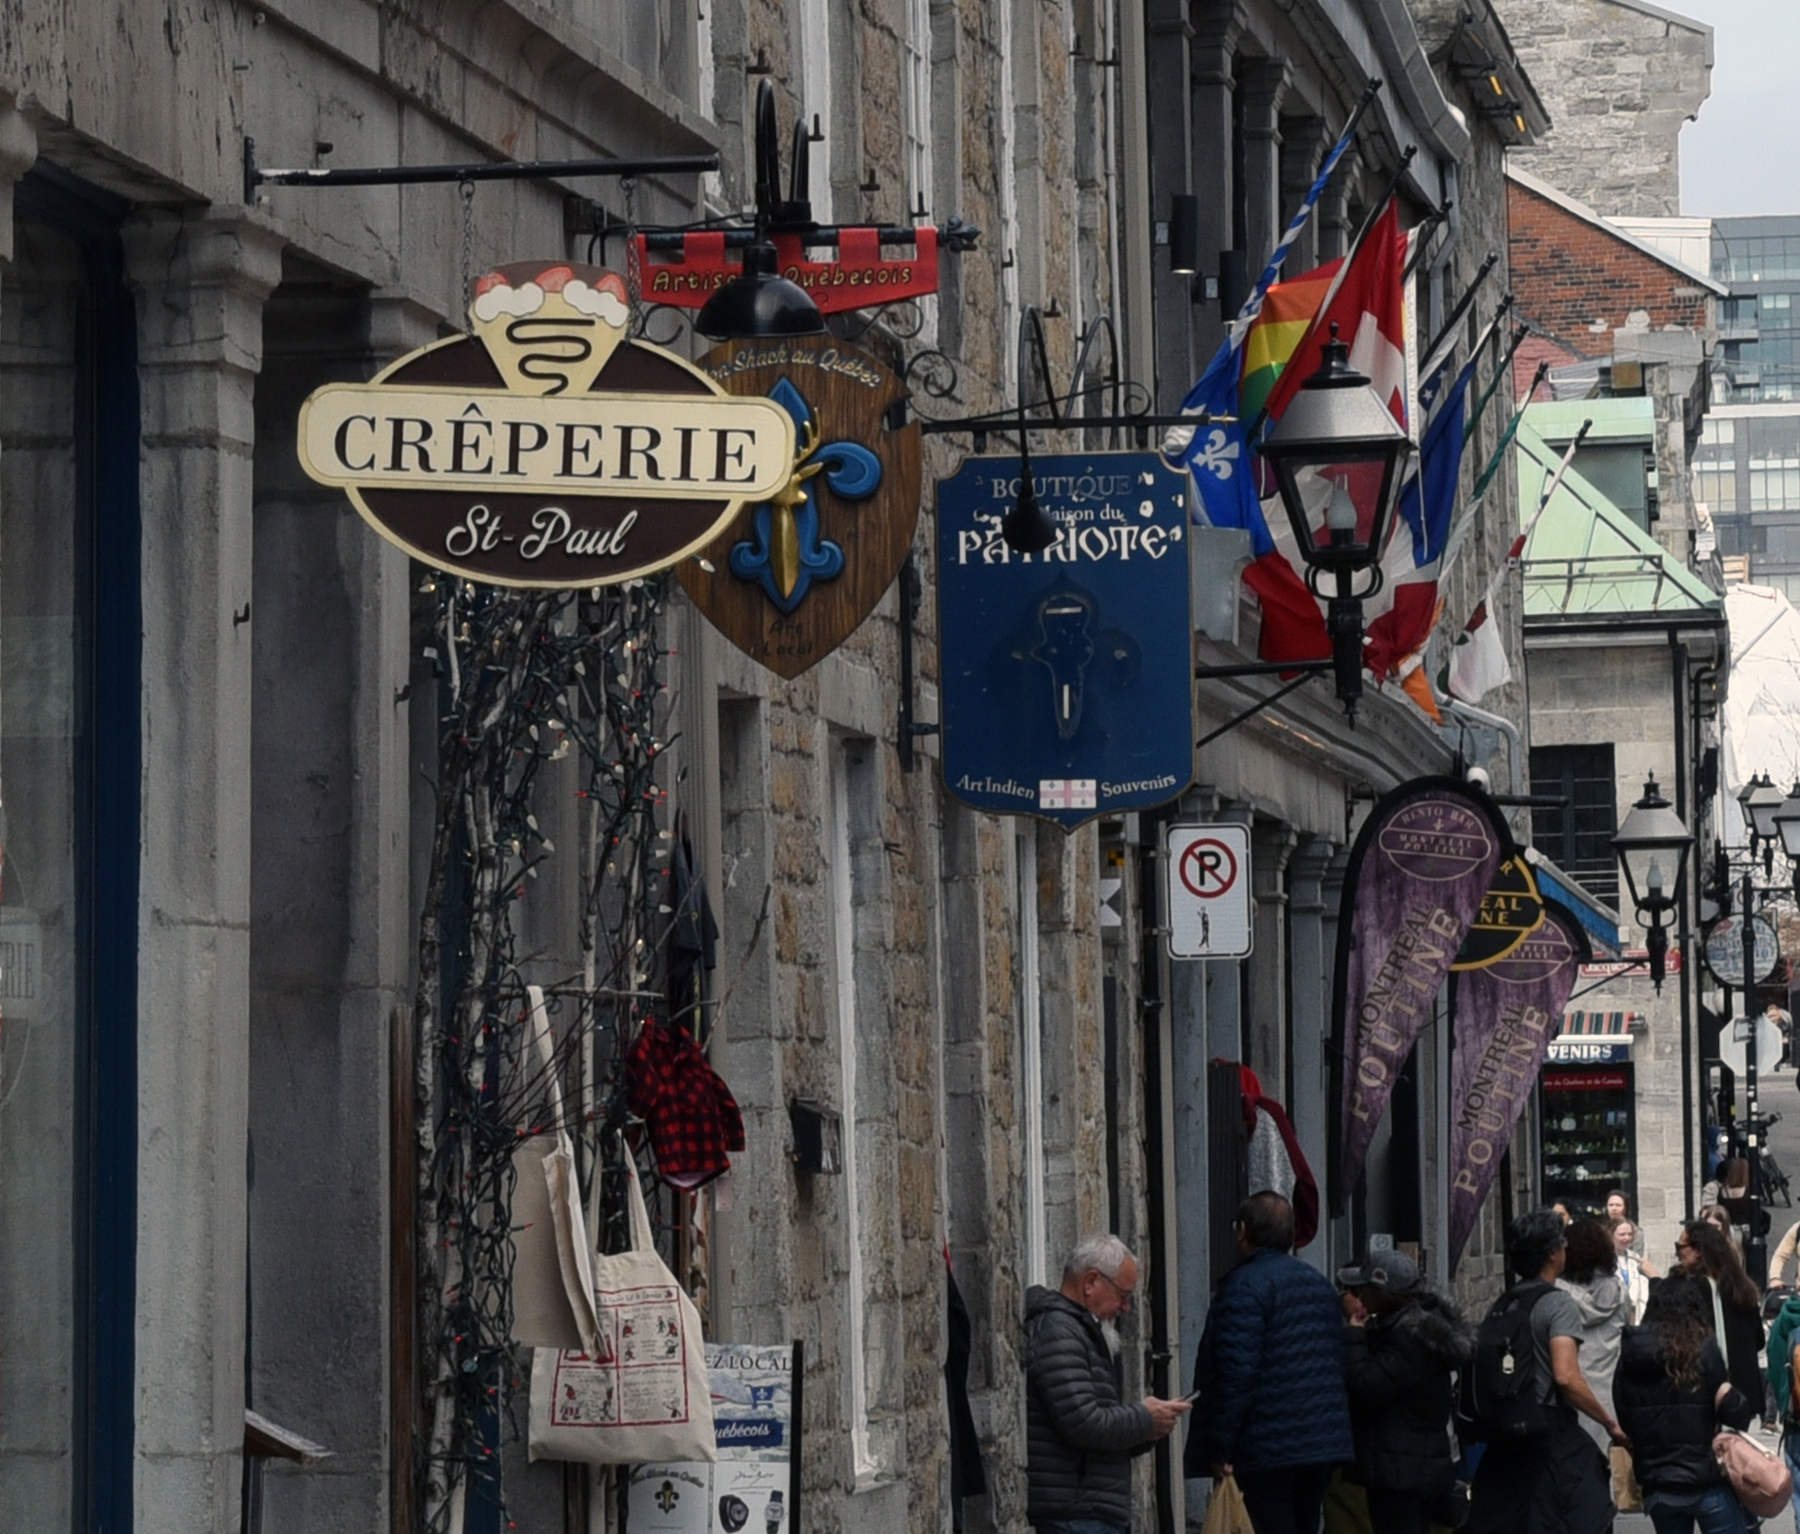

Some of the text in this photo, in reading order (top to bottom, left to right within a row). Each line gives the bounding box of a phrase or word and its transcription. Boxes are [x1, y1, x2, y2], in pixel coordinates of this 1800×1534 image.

[734, 343, 788, 373] Shack
[791, 350, 815, 365] au
[819, 347, 881, 388] Québec
[333, 401, 758, 486] CRÊPERIE
[446, 504, 638, 560] St-Paul
[1100, 503, 1121, 521] du
[958, 524, 1168, 565] PARIOTE
[1101, 774, 1177, 798] Souvenirs
[1400, 833, 1473, 848] MONTREAL
[1404, 842, 1465, 857] POUTINE
[1356, 901, 1435, 1050] MONTREAL
[1349, 907, 1461, 1124] POUTINE
[1457, 1003, 1527, 1133] MONTREAL
[1547, 1045, 1612, 1059] VENIRS
[1454, 1006, 1550, 1196] POUTINE
[729, 1354, 792, 1372] LOCAL
[713, 1421, 770, 1439] uébécois
